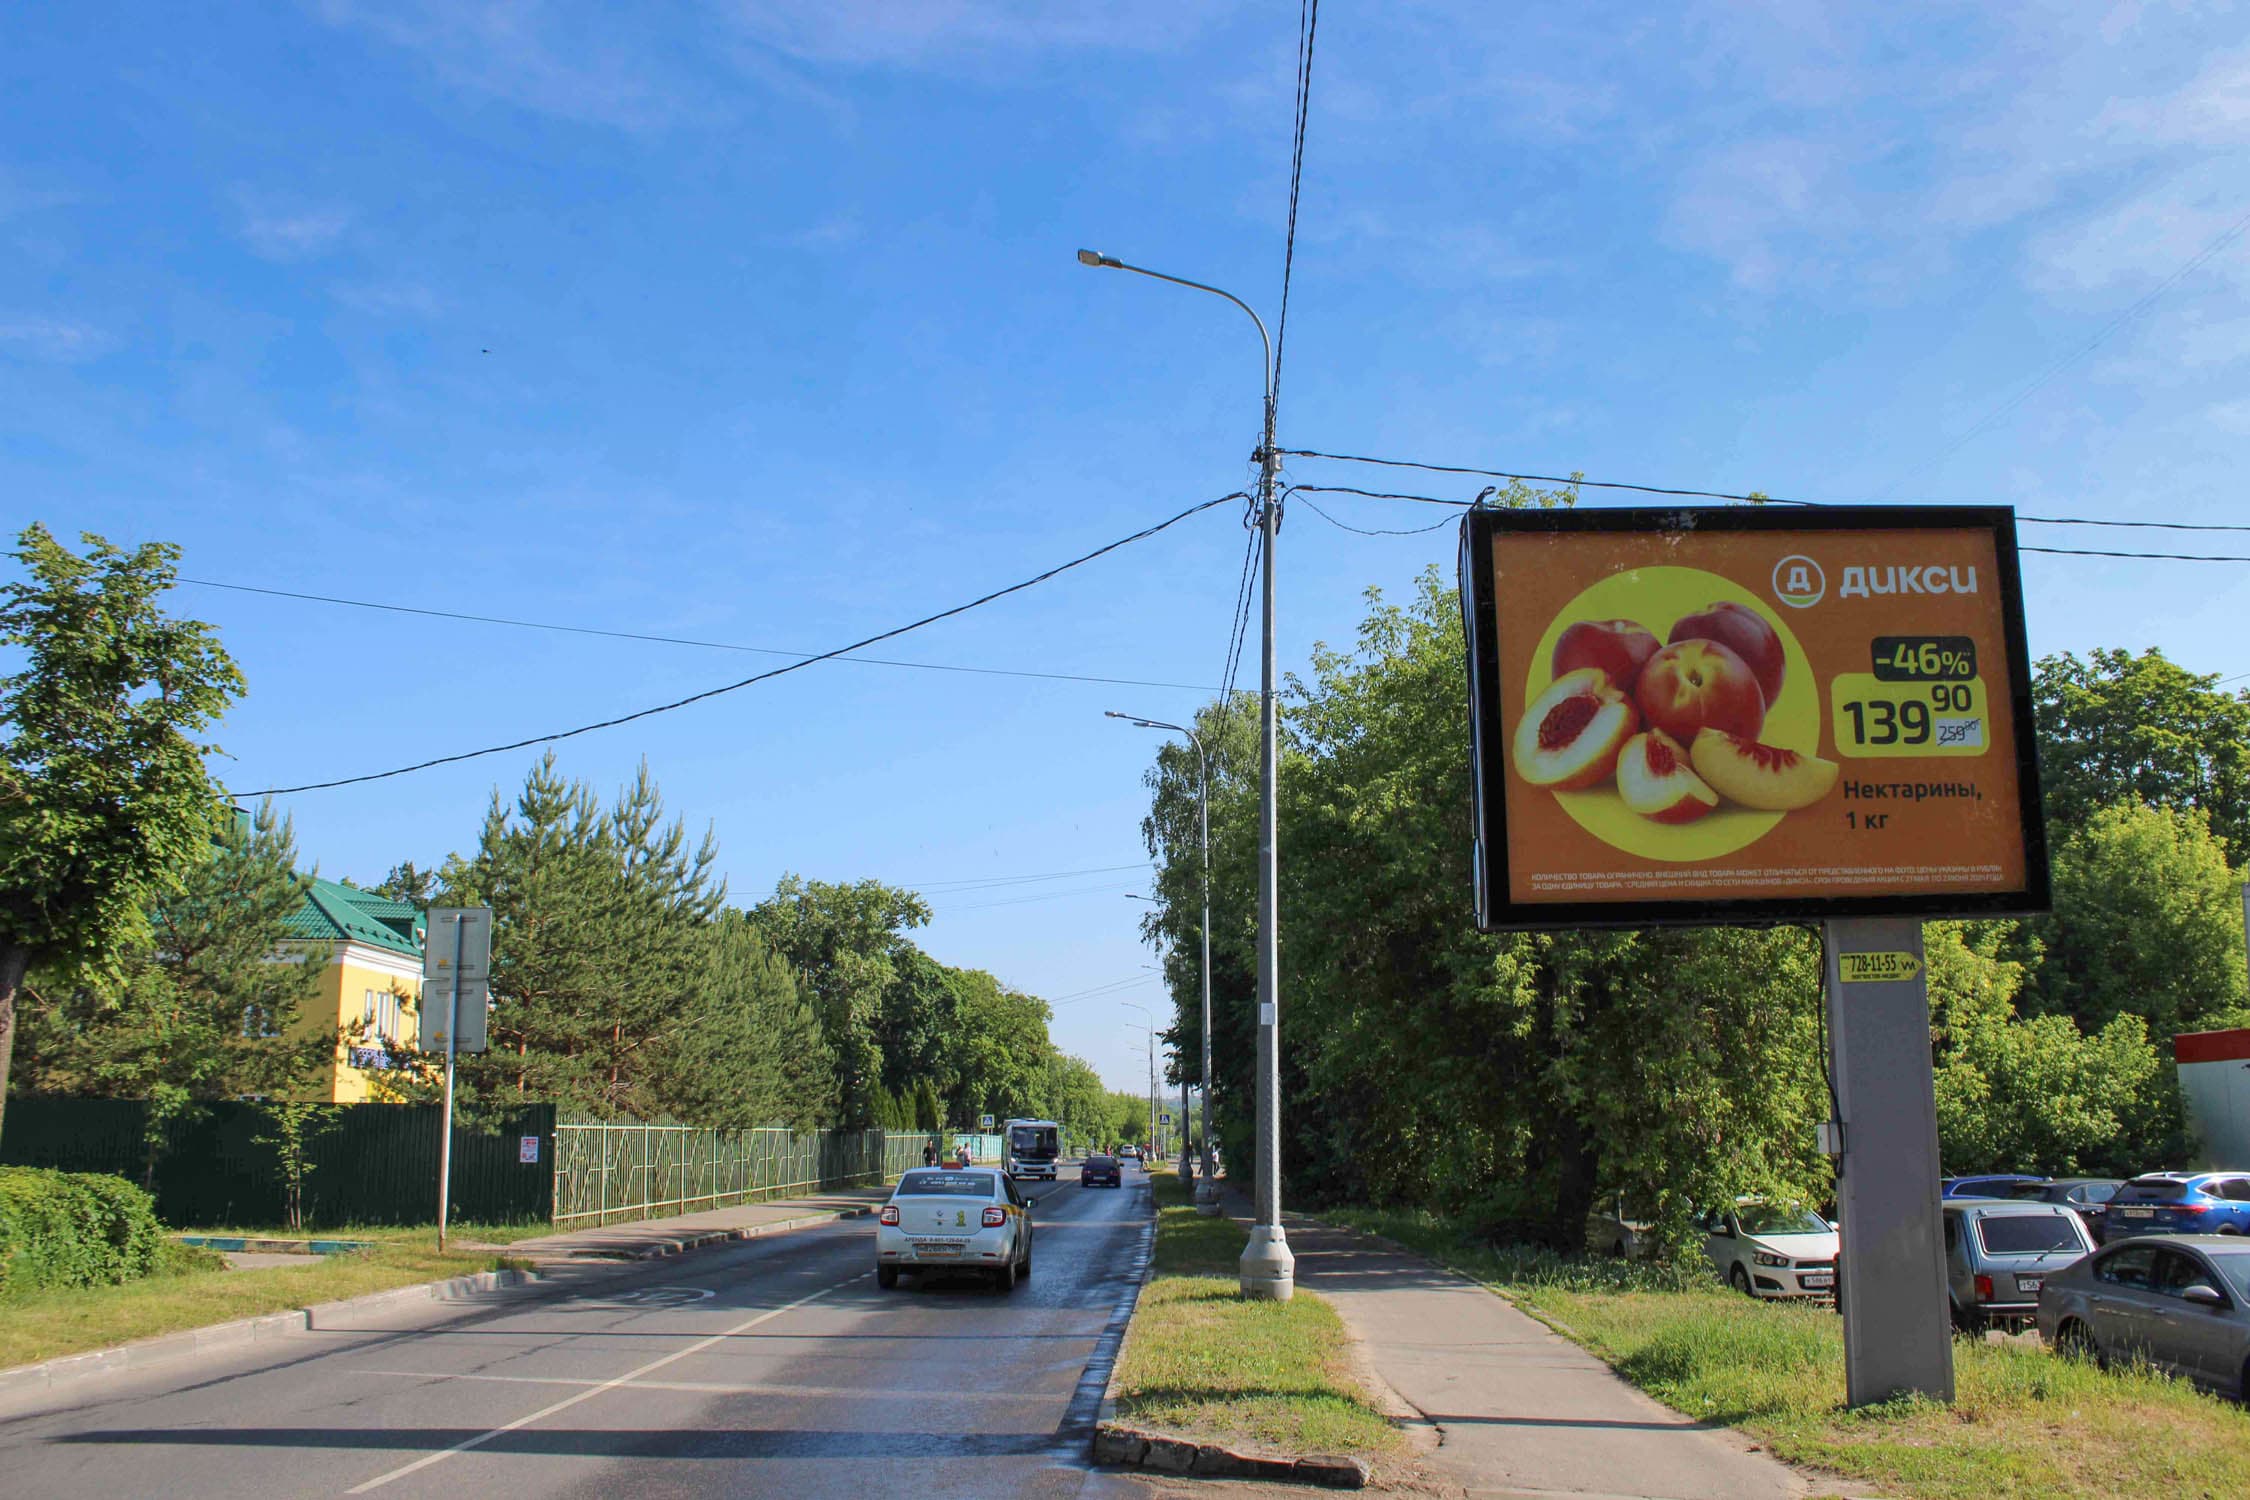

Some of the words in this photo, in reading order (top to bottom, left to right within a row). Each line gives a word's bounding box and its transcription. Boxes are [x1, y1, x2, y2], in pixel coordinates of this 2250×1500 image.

[1842, 699, 1931, 745] 139
[1931, 684, 1973, 712] 90
[1843, 780, 1982, 801] Нектарины,
[1846, 812, 1856, 830] 1
[1865, 813, 1889, 830] кг
